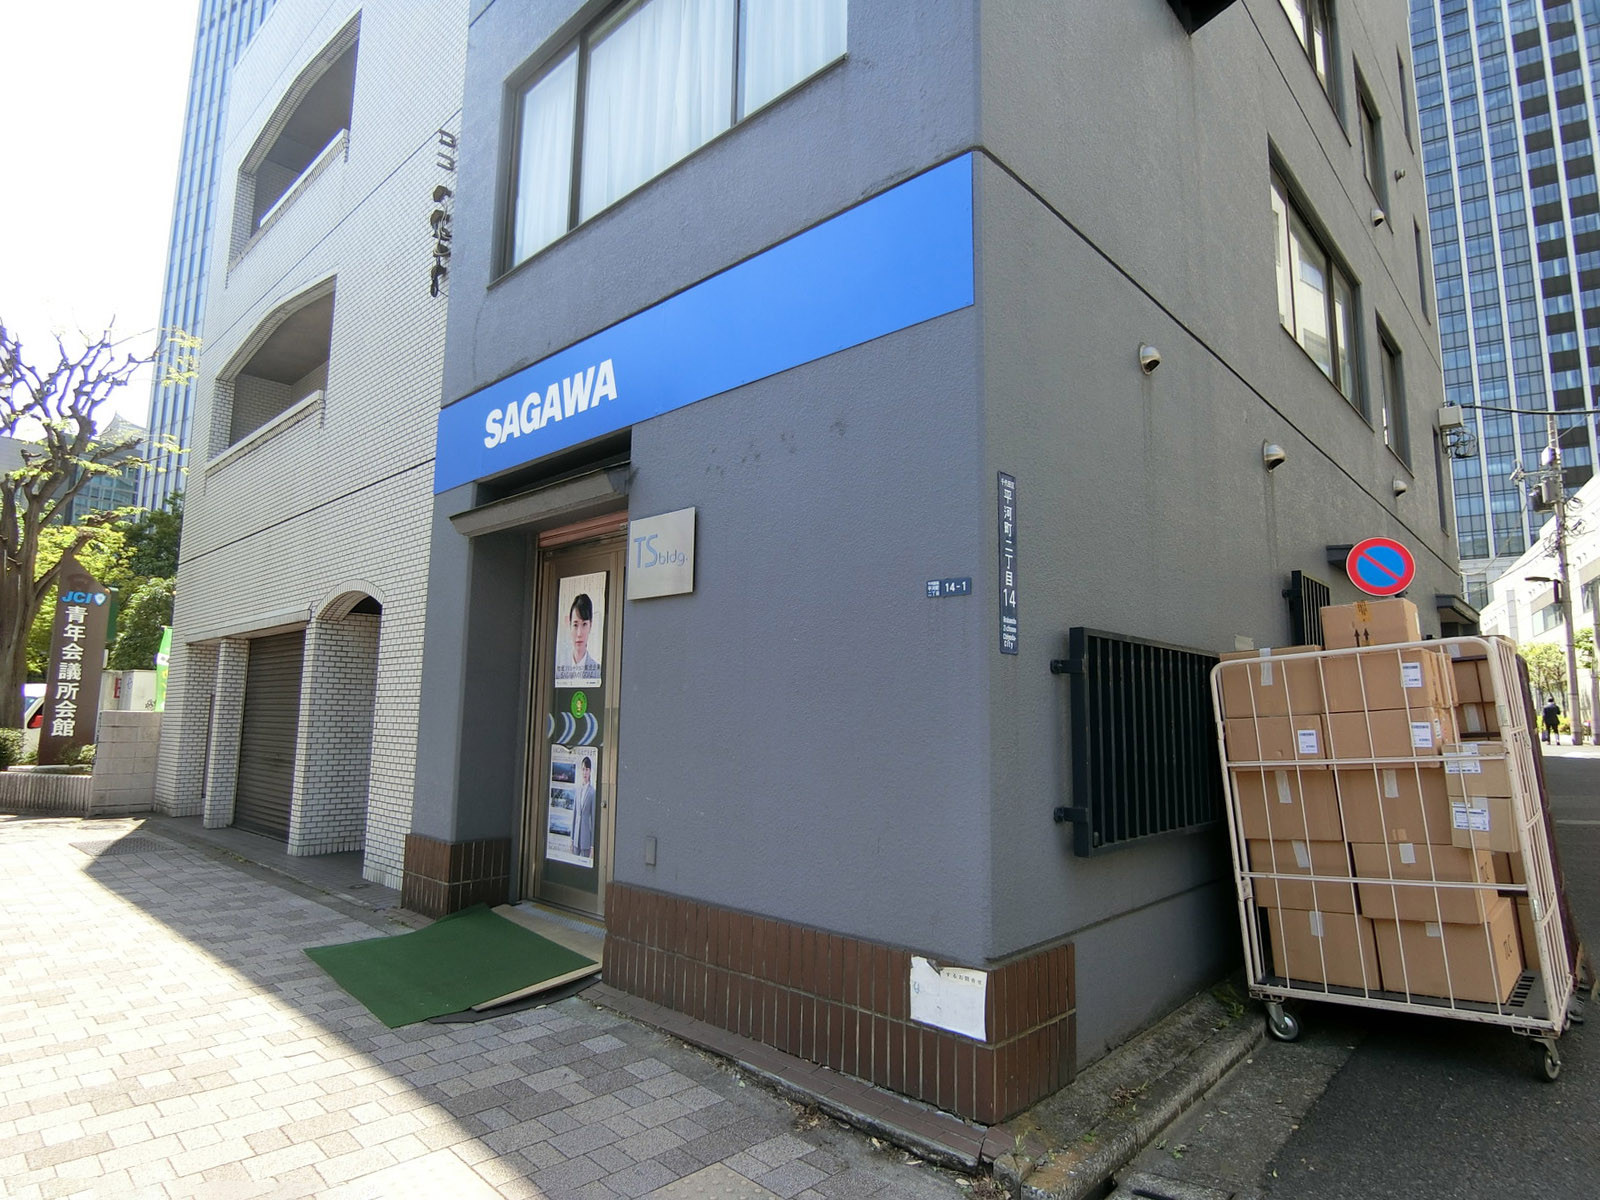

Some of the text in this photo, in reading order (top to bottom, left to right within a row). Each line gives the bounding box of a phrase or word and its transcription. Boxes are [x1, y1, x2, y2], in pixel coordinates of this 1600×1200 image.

[483, 358, 618, 449] SAGAWA
[945, 581, 966, 593] 14-1
[61, 591, 91, 604] JCI
[1002, 588, 1016, 608] 14
[51, 605, 88, 737] 青年会議所会館
